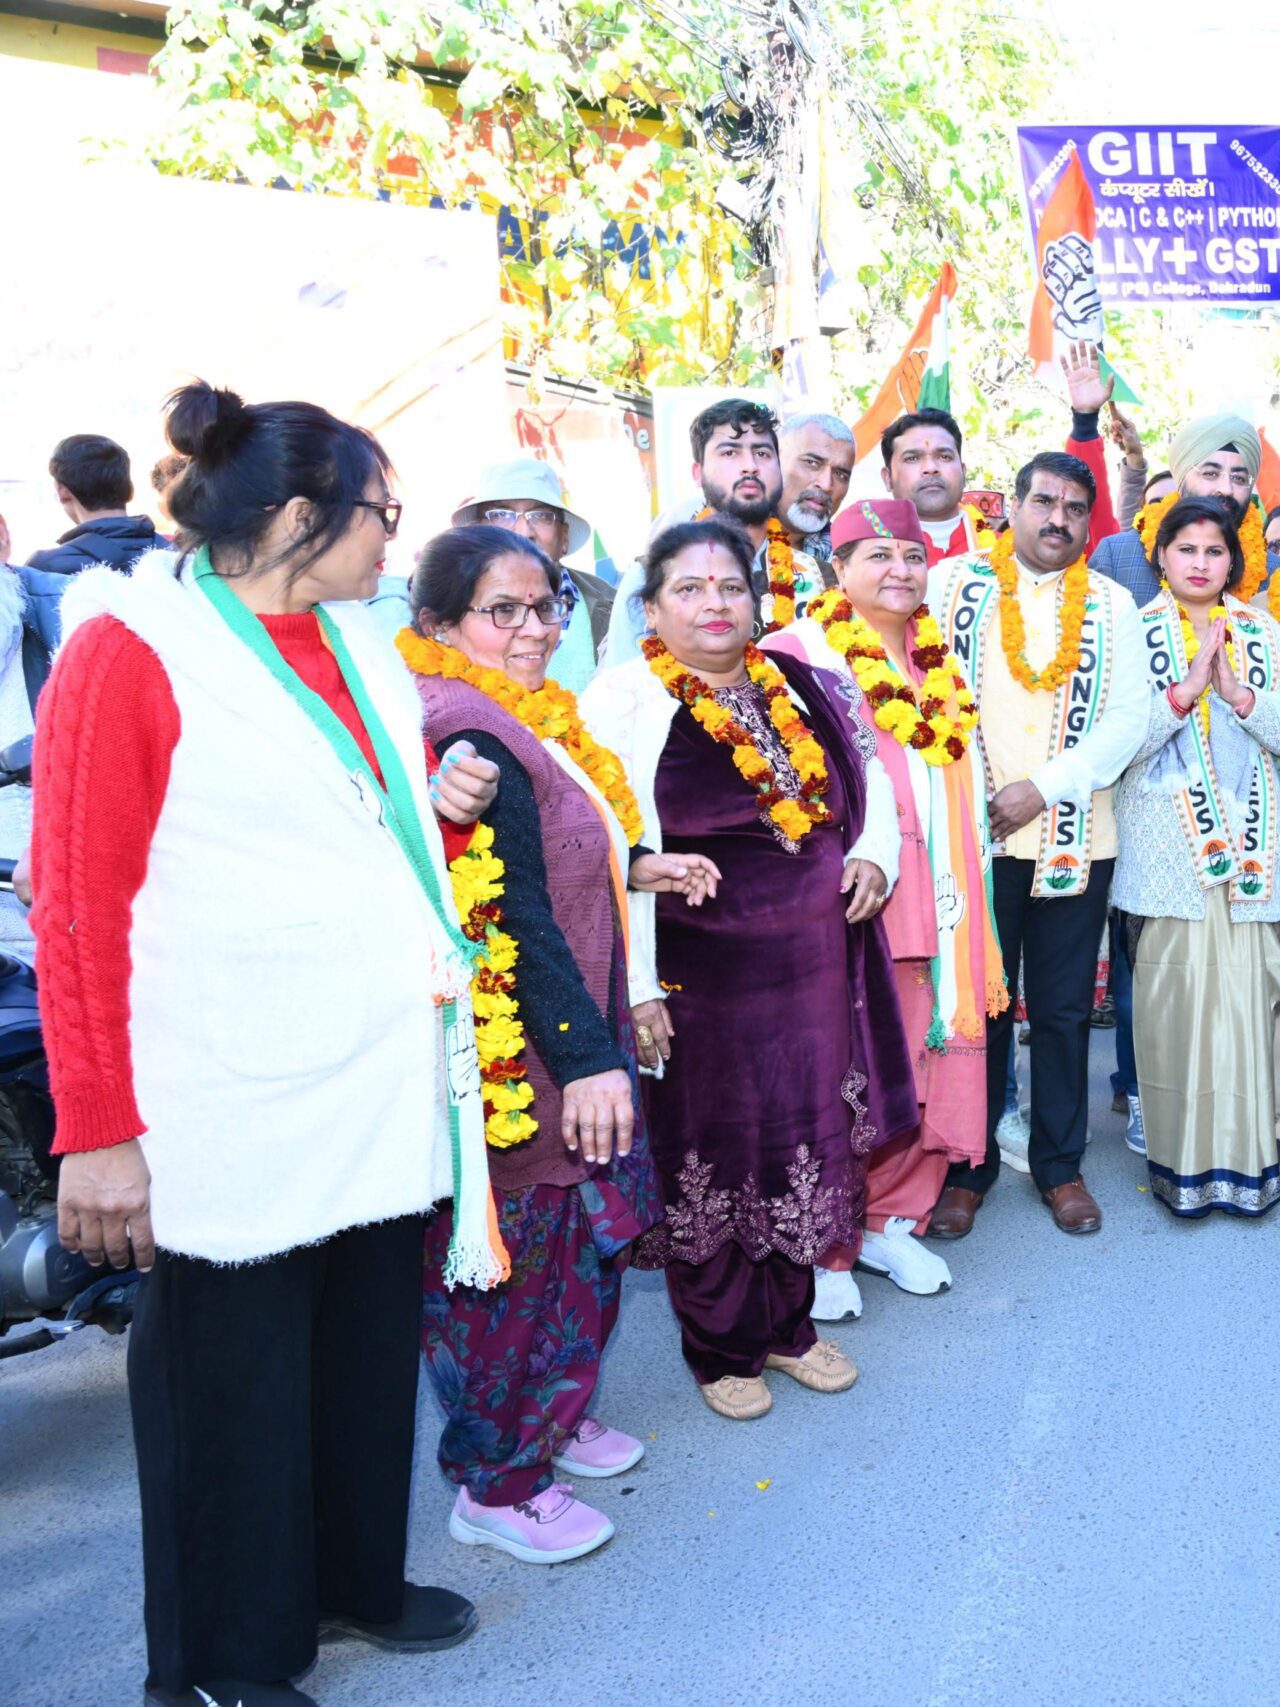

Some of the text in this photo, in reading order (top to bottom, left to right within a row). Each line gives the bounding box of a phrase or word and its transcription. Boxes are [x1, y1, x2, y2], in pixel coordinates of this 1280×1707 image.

[1087, 131, 1217, 176] GIIT
[1139, 206, 1152, 228] C
[1156, 206, 1169, 228] &
[1173, 206, 1205, 228] C++
[1209, 280, 1271, 295] Dehradun
